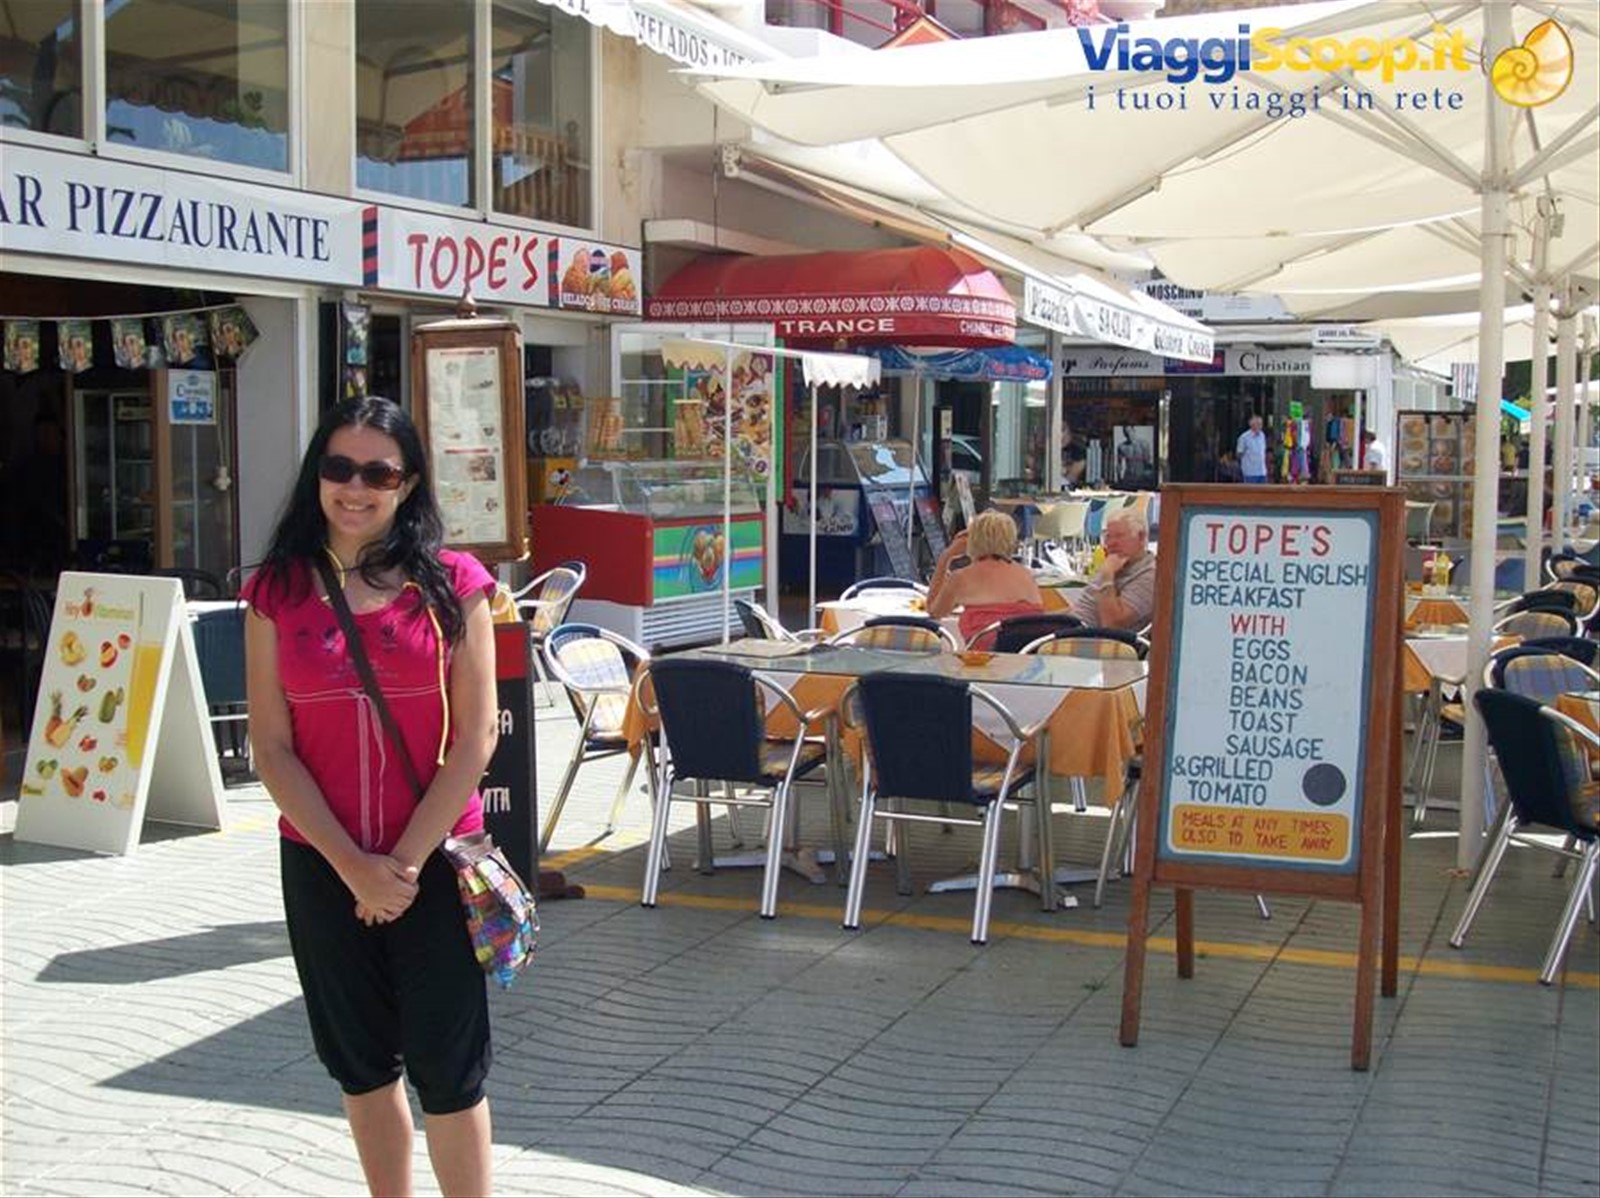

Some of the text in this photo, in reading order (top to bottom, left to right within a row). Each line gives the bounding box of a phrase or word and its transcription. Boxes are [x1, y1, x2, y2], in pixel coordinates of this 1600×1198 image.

[634, 11, 709, 67] HELADOS
[66, 181, 331, 262] PIZZAURANTE
[406, 231, 541, 292] TOPE'S
[1239, 351, 1311, 373] Christian
[1205, 523, 1332, 557] TOPE'S
[1190, 560, 1368, 587] SPECIAL ENGLISH
[1190, 585, 1306, 609] BREAKFAST
[1230, 613, 1285, 636] WITH
[1232, 638, 1291, 660] EGGS
[1230, 661, 1308, 686] BACON
[1229, 686, 1303, 710] BEANS
[1229, 709, 1298, 733] TOAST
[1226, 734, 1324, 760] SAUSAGE
[1171, 756, 1273, 782] &GRILLED
[1187, 780, 1267, 807] TOMATO
[1181, 811, 1332, 835] MEALS AT ANY TIMES
[1228, 831, 1244, 846] TO
[1256, 834, 1288, 850] TAKE
[1300, 837, 1334, 852] AWAY
